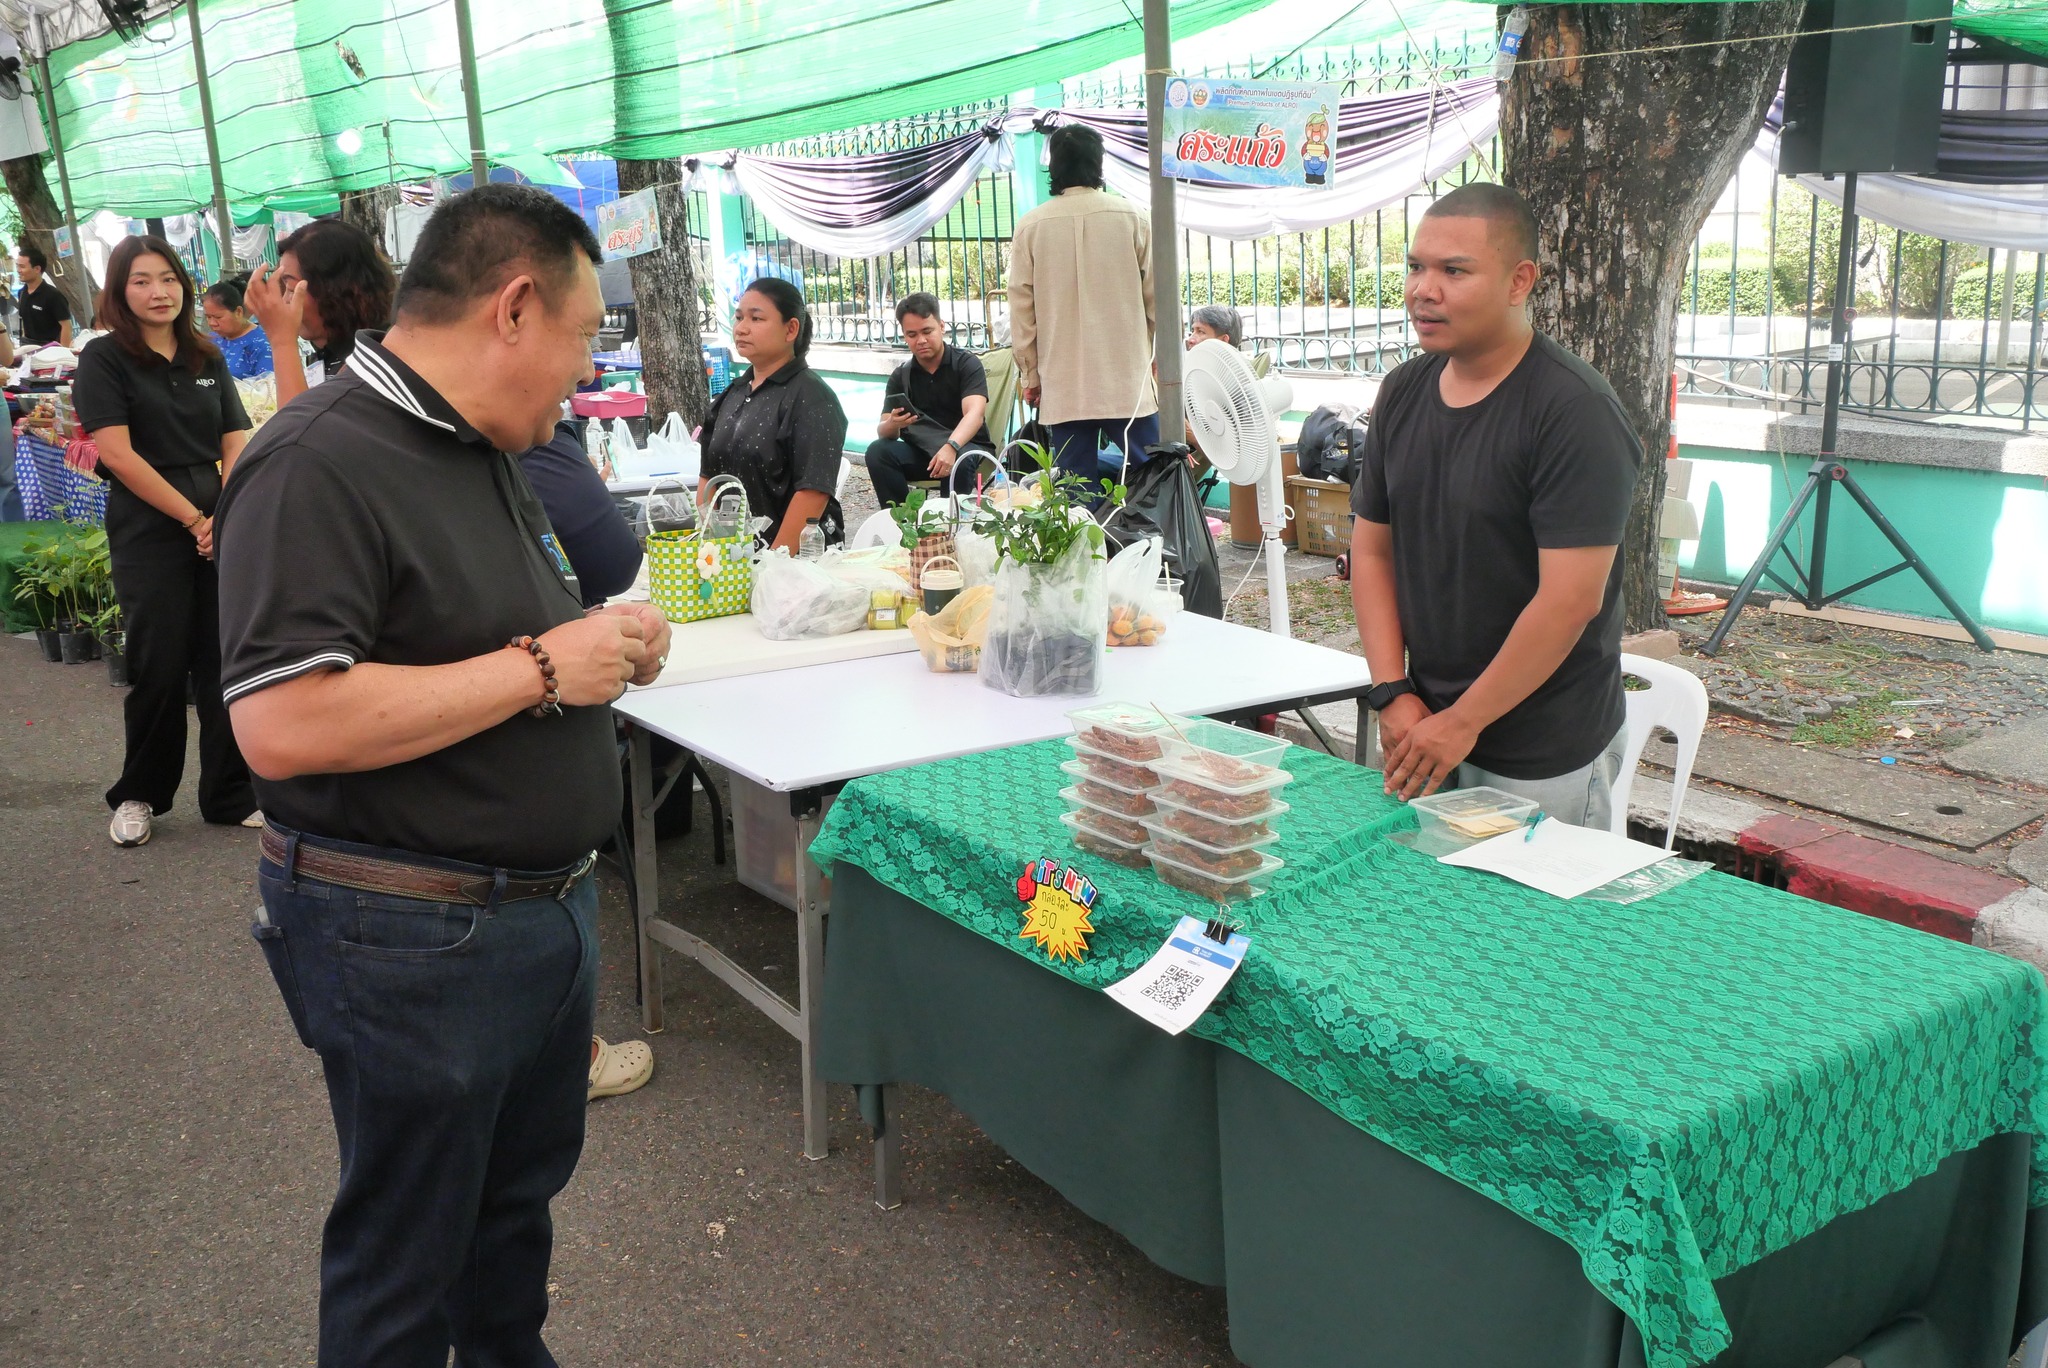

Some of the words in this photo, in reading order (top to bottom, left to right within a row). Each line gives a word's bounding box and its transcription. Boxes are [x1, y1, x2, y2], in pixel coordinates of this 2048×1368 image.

[1251, 100, 1273, 108] Products
[1179, 123, 1287, 168] สระแก้ว
[608, 219, 644, 252] สระบุรี
[1041, 888, 1070, 912] กล่องละ
[1062, 866, 1097, 908] NEW
[1039, 909, 1057, 929] 50
